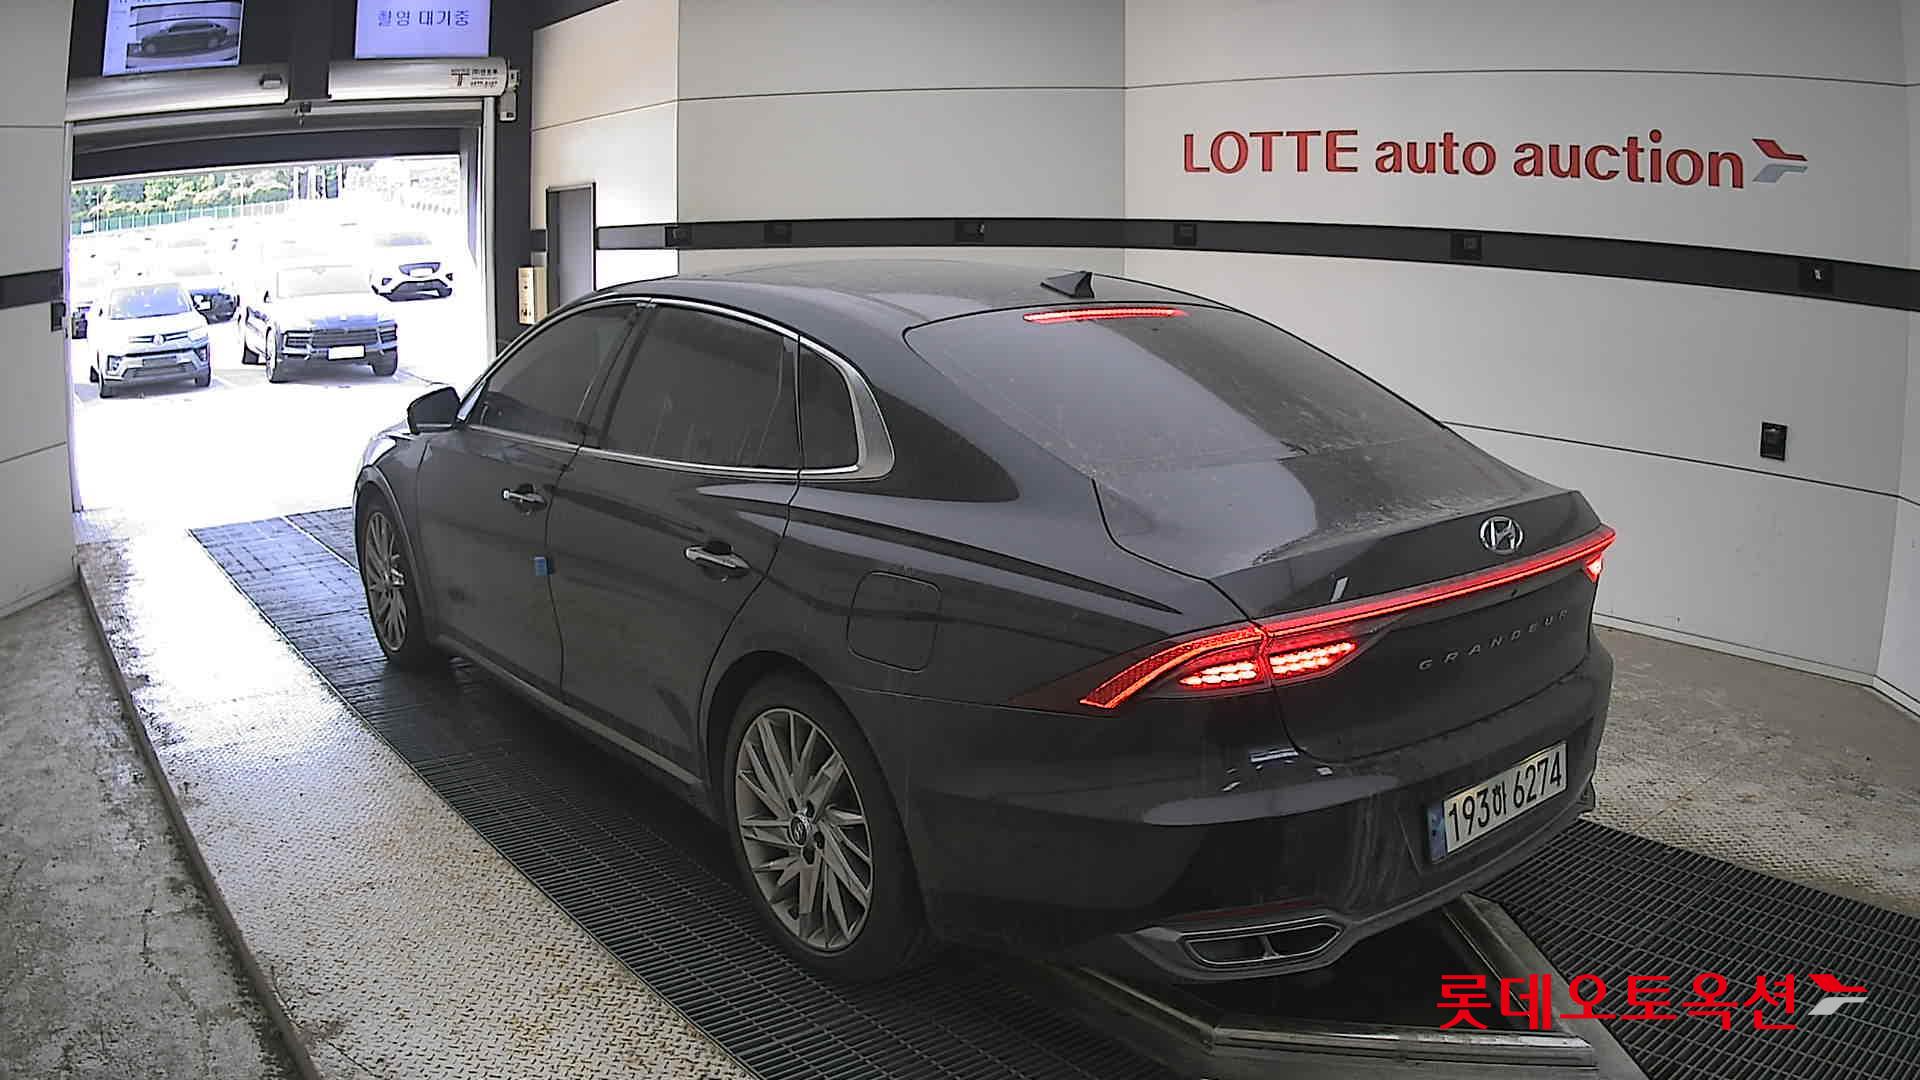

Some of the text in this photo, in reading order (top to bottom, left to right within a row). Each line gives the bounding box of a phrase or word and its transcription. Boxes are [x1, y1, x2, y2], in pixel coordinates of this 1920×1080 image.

[419, 9, 469, 27] 대기중
[1183, 129, 1745, 189] LOTTE auto auction
[1418, 608, 1568, 671] GRANDEUR
[1448, 751, 1563, 841] 193하 6274
